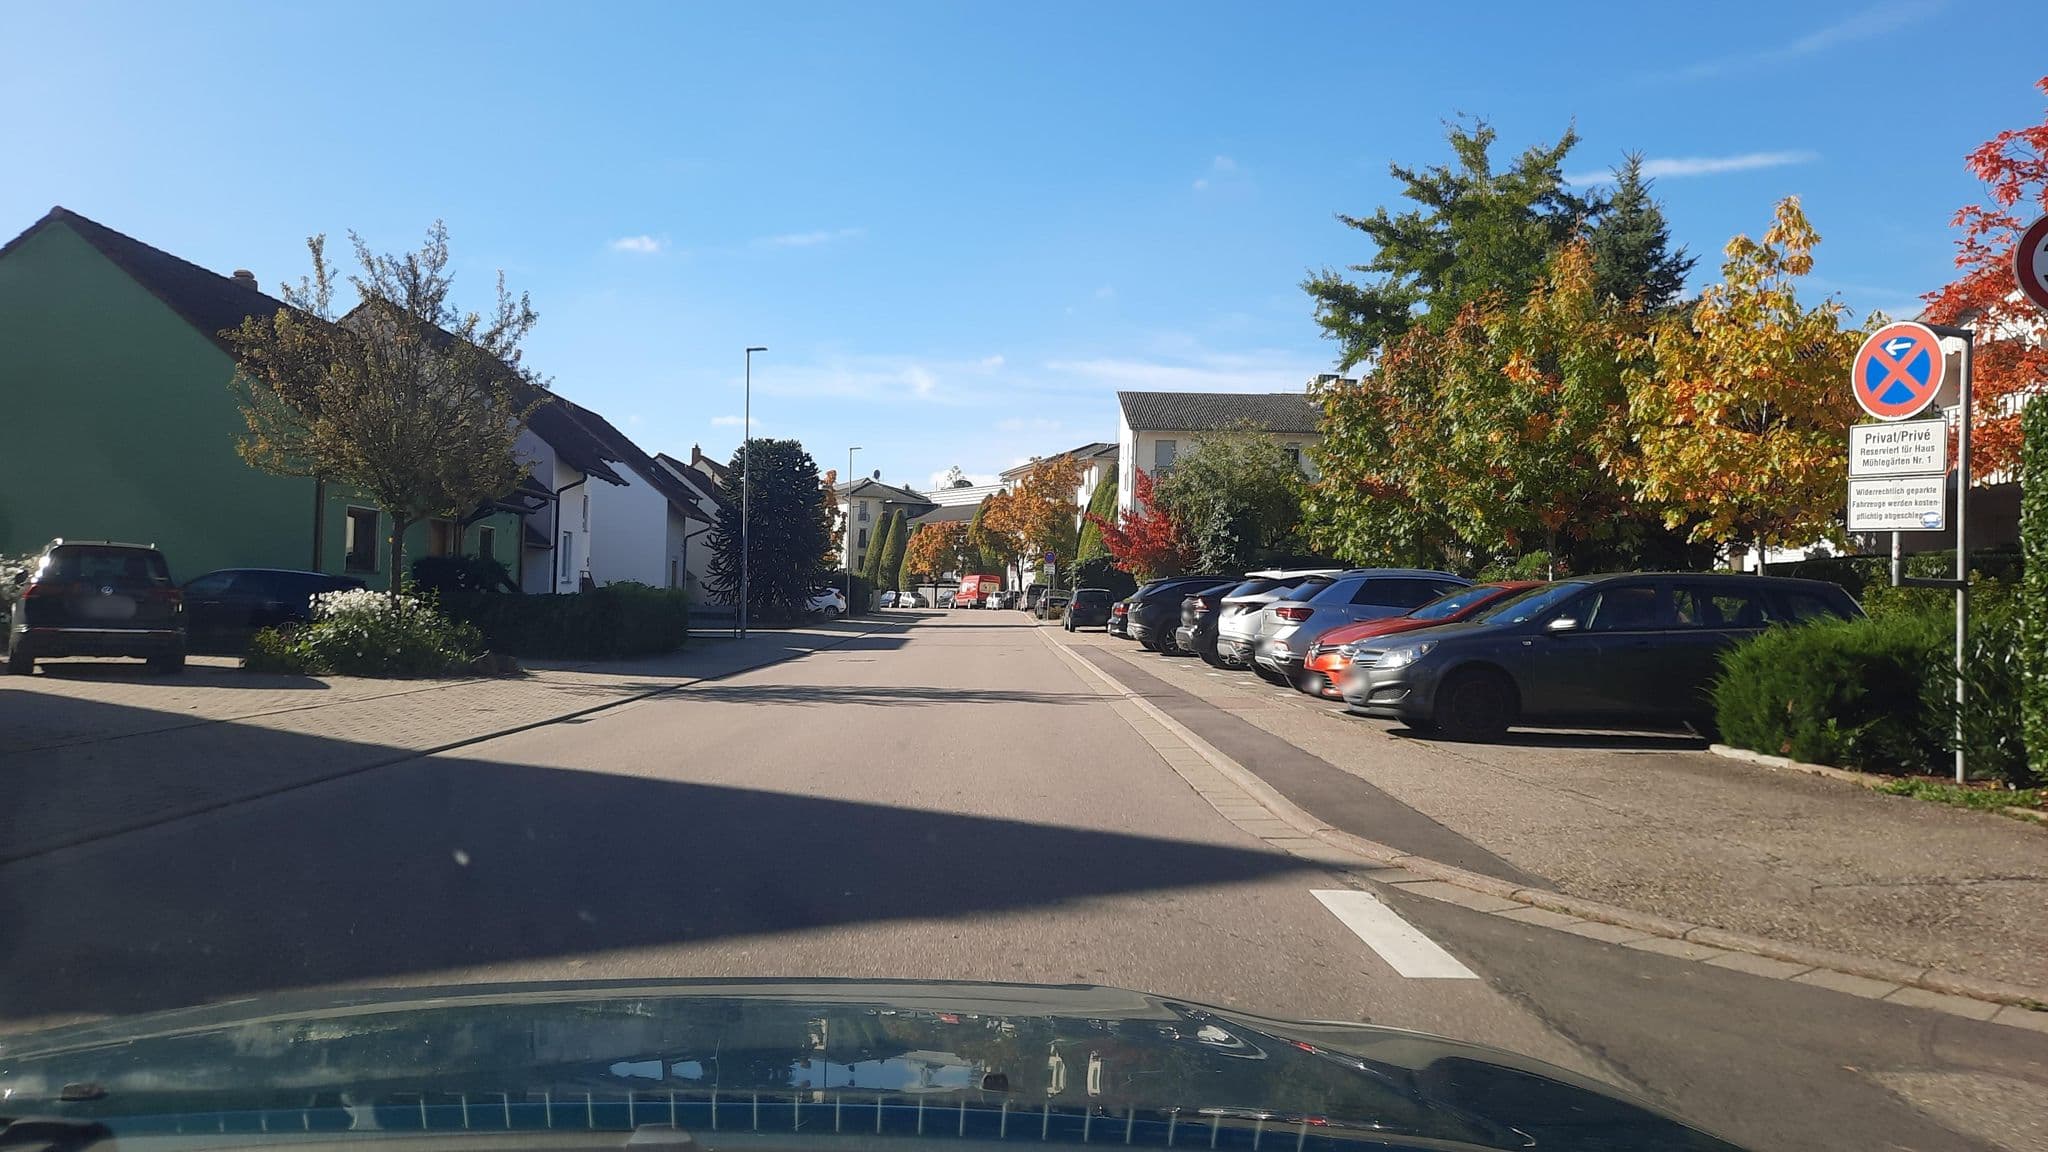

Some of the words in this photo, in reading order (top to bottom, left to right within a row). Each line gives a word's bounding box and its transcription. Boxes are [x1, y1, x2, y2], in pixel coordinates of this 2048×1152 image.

[1865, 428, 1931, 444] Privat/Privé
[1860, 446, 1900, 456] Reserviert
[1901, 444, 1912, 453] für
[1914, 444, 1936, 453] Haus
[1913, 456, 1924, 464] Nr.
[1927, 455, 1932, 464] 1
[1856, 487, 1904, 496] Widerrechtlich
[1906, 487, 1937, 495] geparkte
[1852, 500, 1886, 508] Fahrzeuge
[1887, 499, 1913, 507] werden
[1856, 511, 1883, 520] pflichtig
